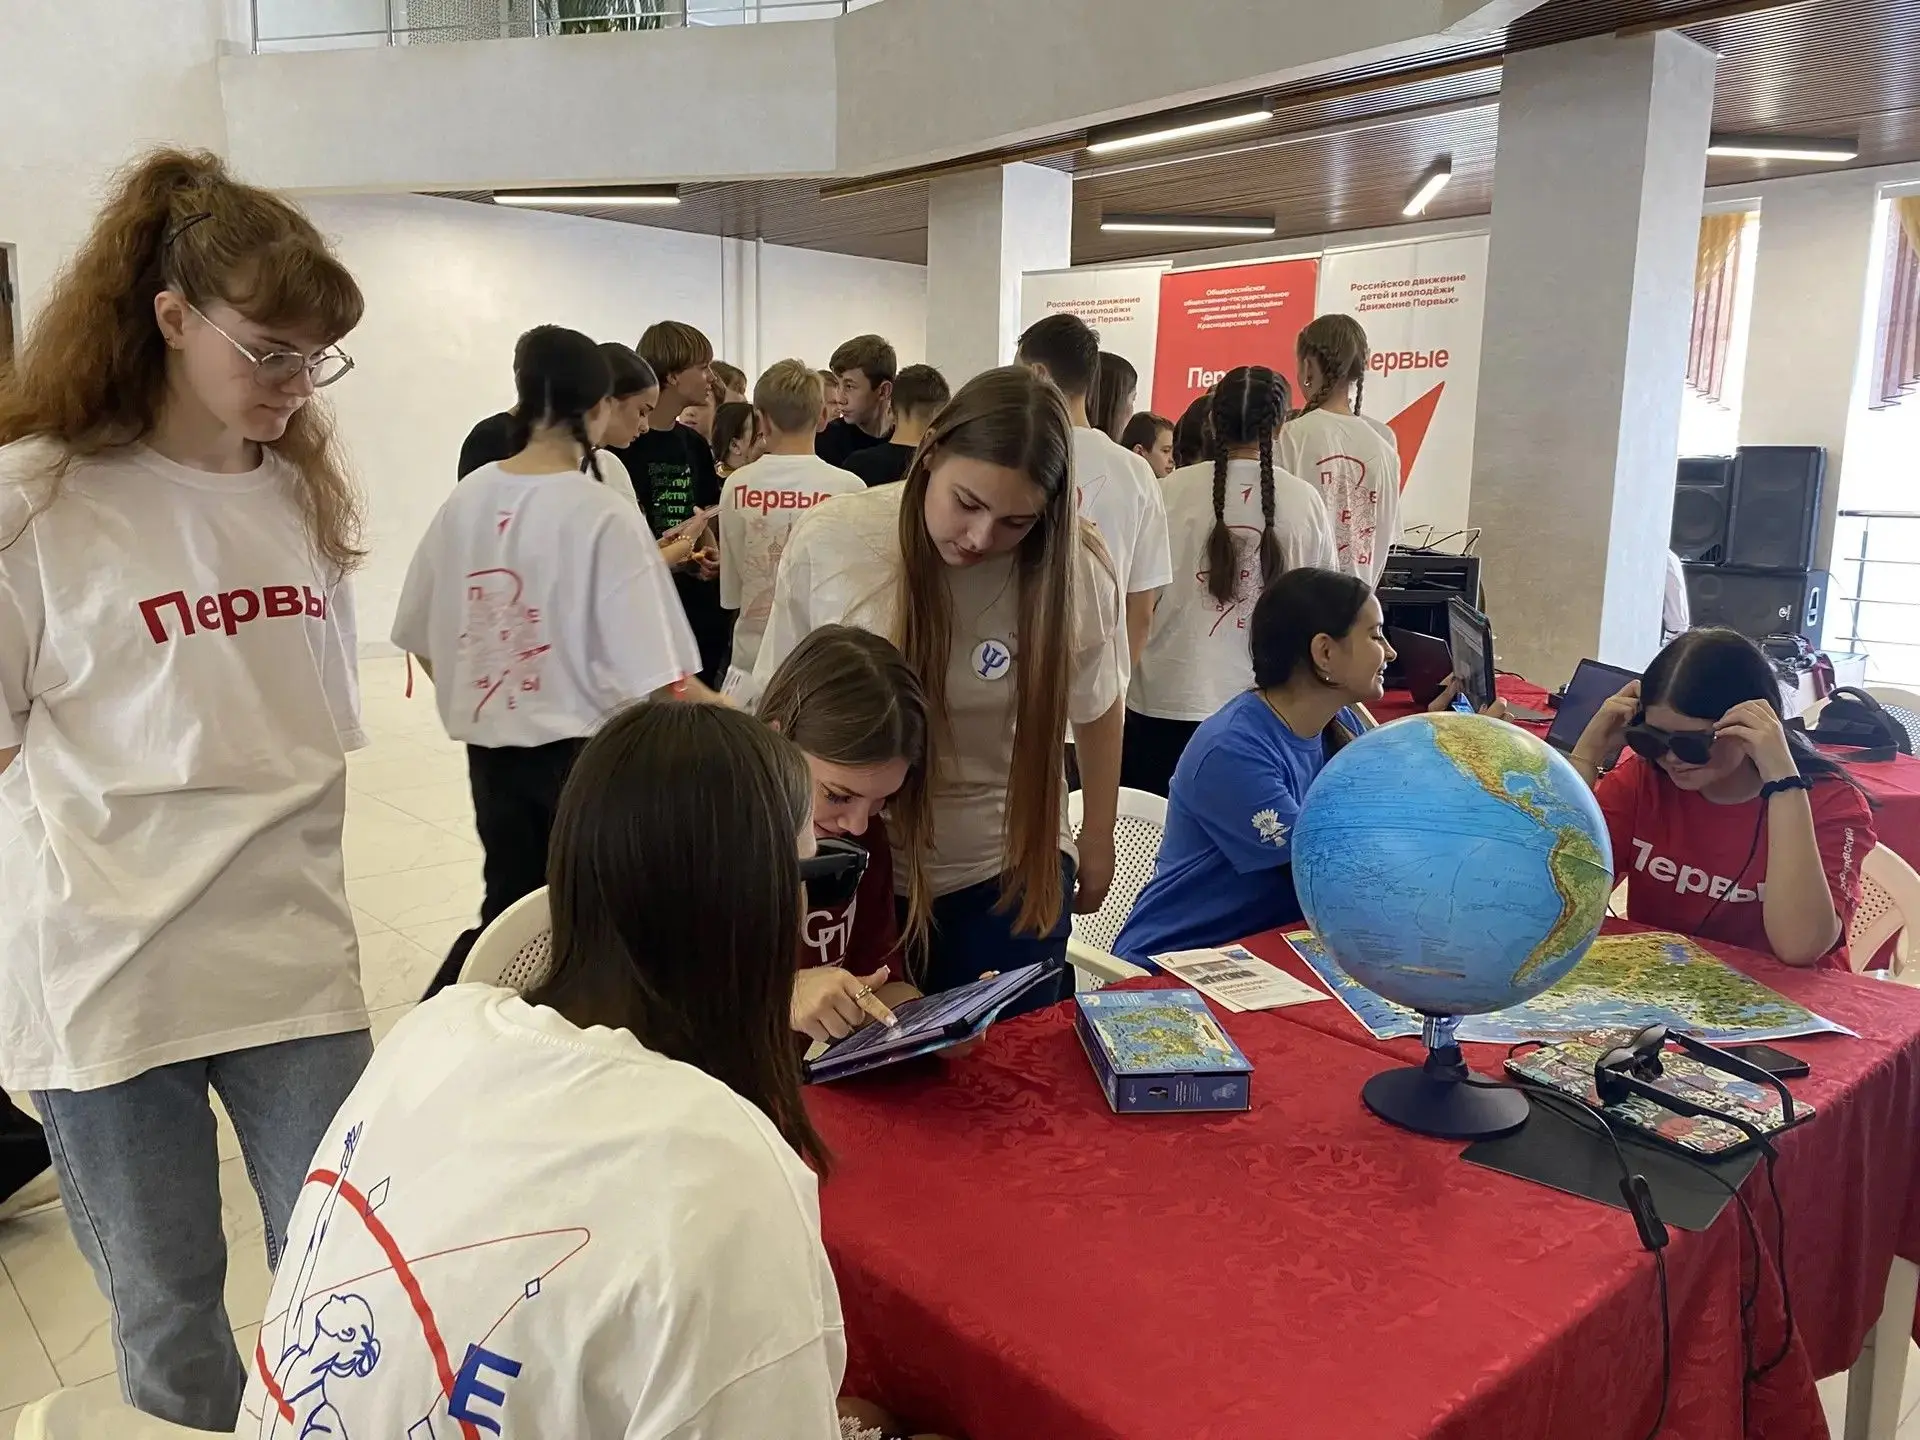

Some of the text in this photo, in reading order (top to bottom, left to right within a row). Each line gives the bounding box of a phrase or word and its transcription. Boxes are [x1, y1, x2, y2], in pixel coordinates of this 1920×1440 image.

[1350, 274, 1466, 291] Российское движение
[1360, 291, 1389, 301] детей
[1399, 286, 1455, 297] молодёжи
[1046, 297, 1141, 308] Российское движение
[1354, 297, 1460, 312] «Движение Первых»
[1086, 307, 1131, 315] молодёжи
[1197, 320, 1252, 330] Краснодарского
[1367, 349, 1449, 378] ервые
[1187, 366, 1227, 389] Пер
[138, 585, 326, 644] Первы
